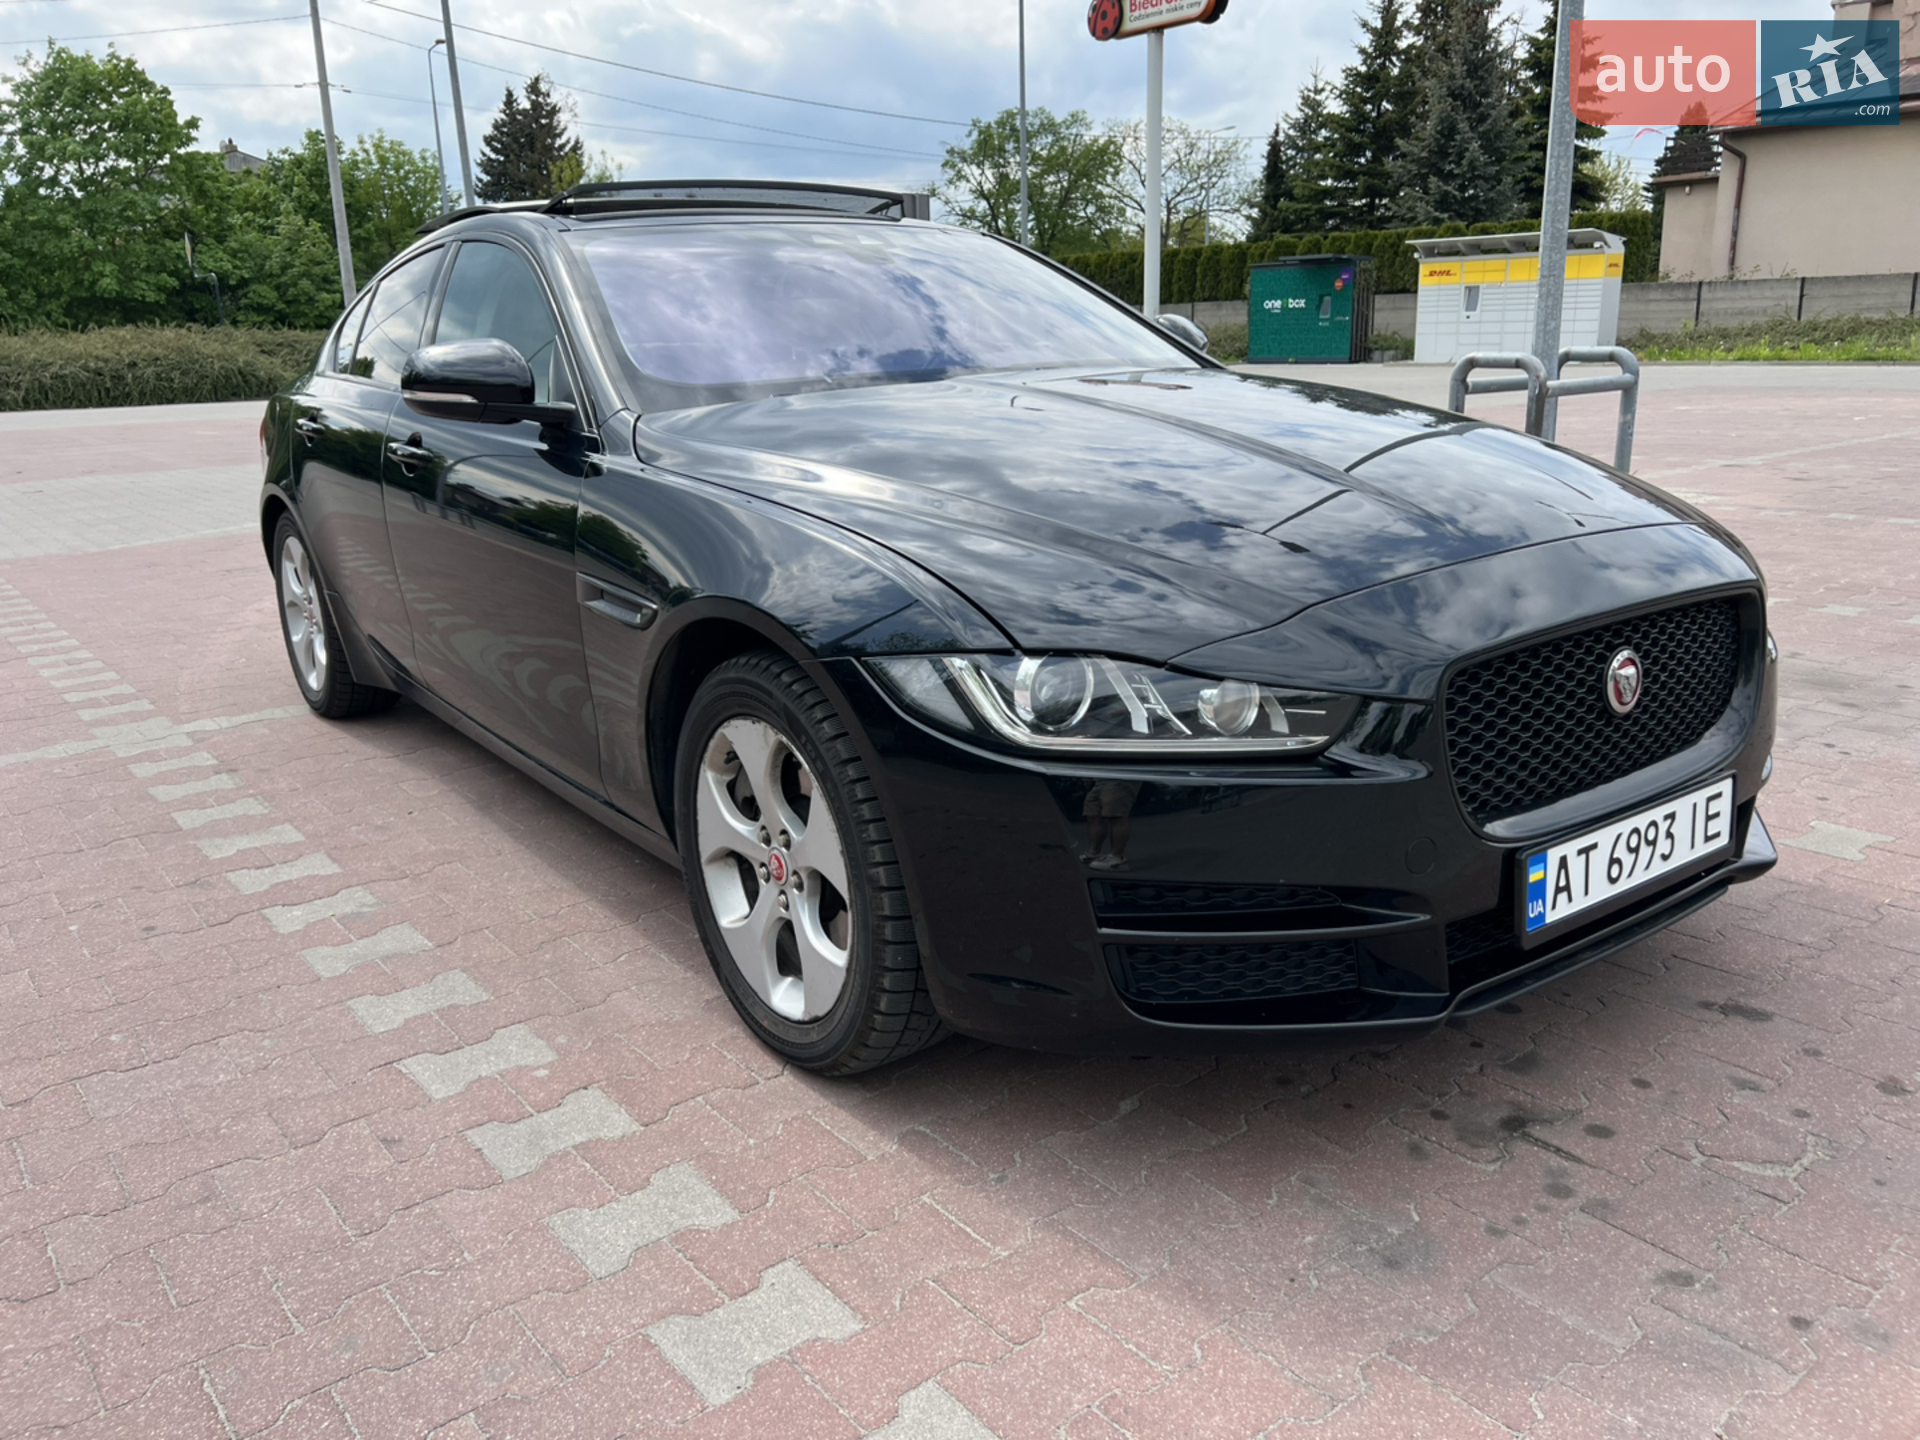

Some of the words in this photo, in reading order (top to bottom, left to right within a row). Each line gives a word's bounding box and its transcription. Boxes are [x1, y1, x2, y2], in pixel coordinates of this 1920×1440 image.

[1129, 8, 1163, 23] Codziennie
[1165, 3, 1184, 14] niskie
[1429, 269, 1452, 277] DHL
[1263, 299, 1282, 309] one
[1288, 298, 1306, 309] box
[1551, 841, 1599, 911] AT
[1607, 810, 1677, 885] 6993
[1690, 790, 1723, 850] IE
[1528, 898, 1544, 918] UA
